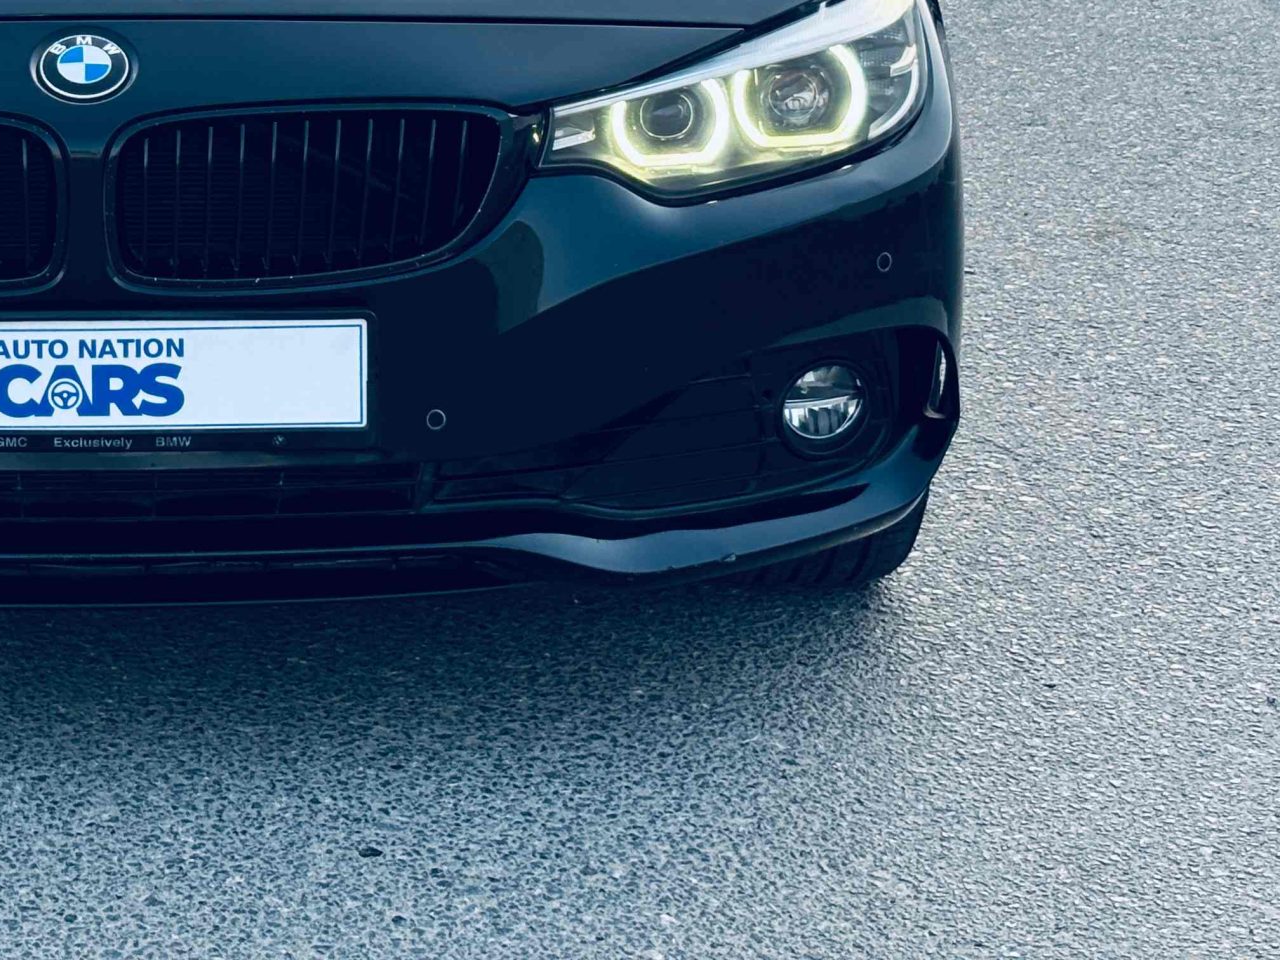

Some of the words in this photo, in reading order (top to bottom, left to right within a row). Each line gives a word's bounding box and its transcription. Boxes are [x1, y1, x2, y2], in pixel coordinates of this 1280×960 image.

[48, 36, 120, 55] BMW
[78, 338, 184, 359] NATION
[53, 436, 133, 450] Exclusively
[155, 436, 192, 448] BMW
